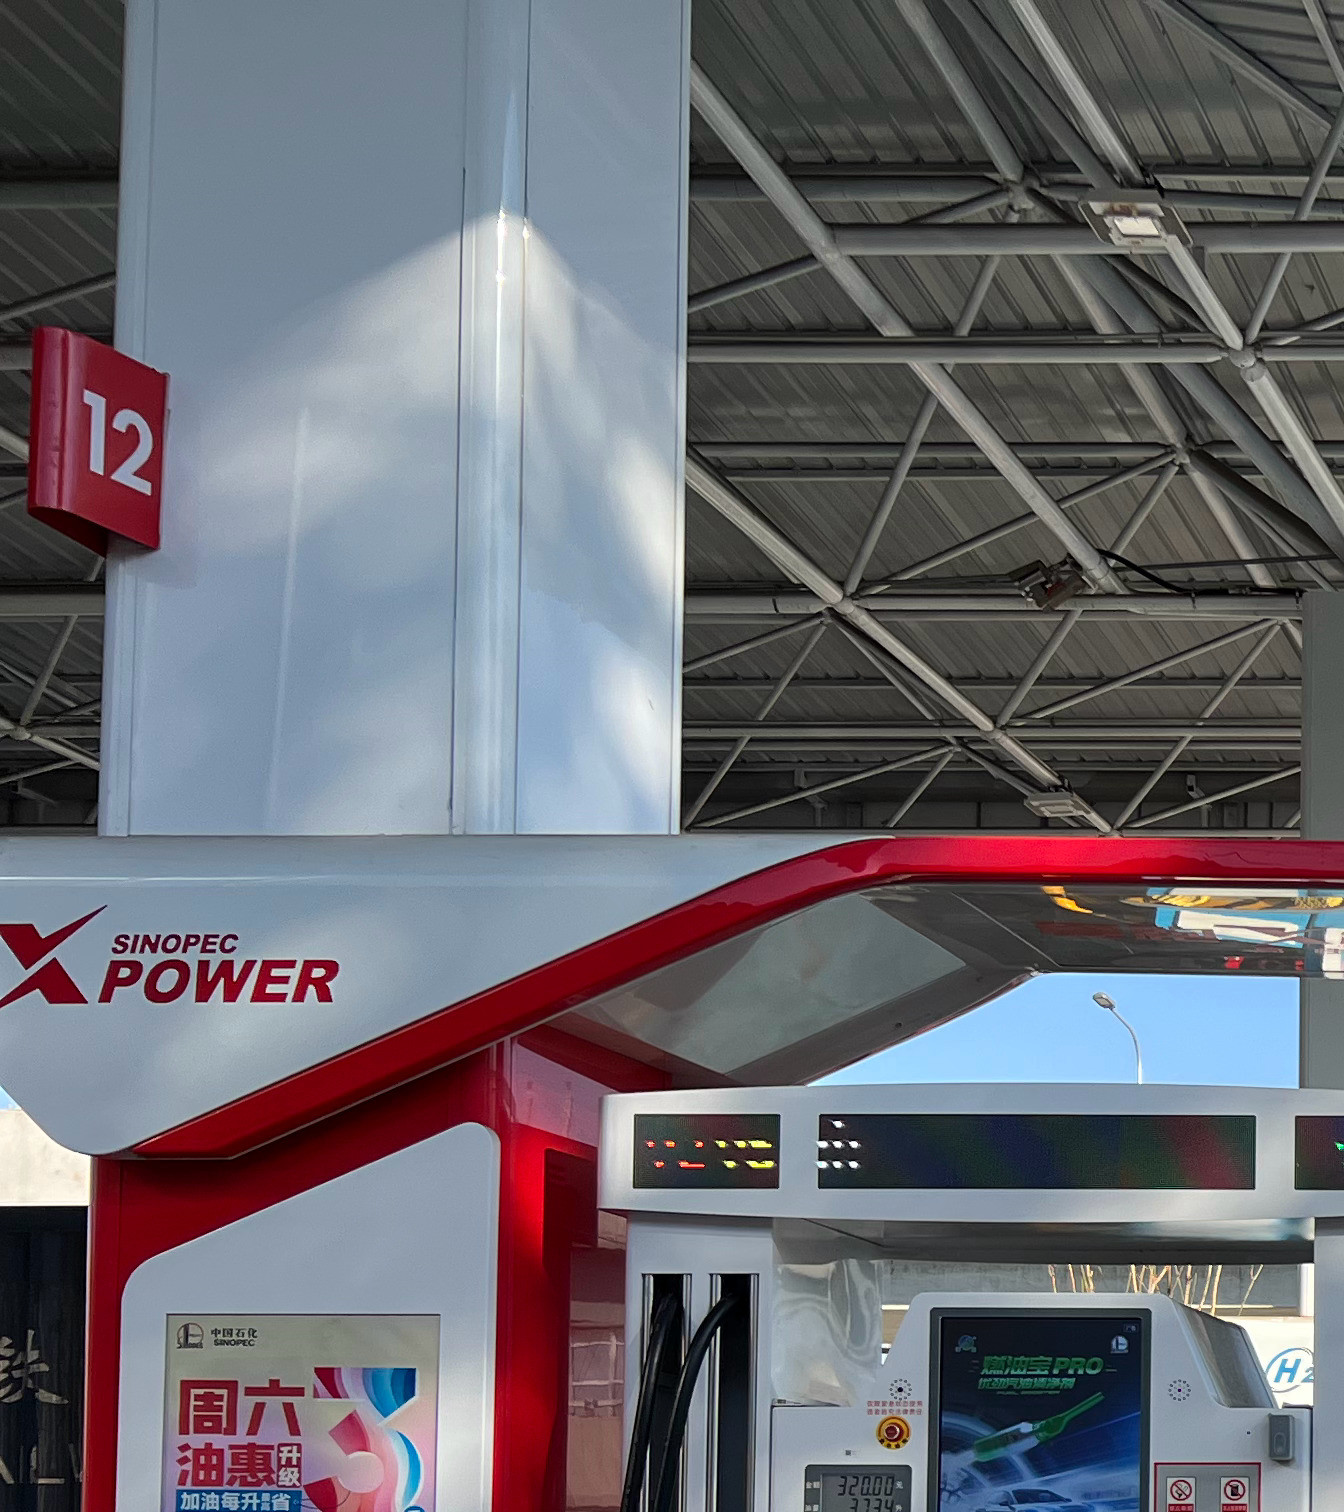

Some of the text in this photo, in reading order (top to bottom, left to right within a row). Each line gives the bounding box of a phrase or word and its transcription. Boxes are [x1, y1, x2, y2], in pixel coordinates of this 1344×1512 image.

[82, 389, 153, 496] 12
[111, 933, 239, 955] SINOPEC
[98, 959, 340, 1004] POWER
[210, 1327, 258, 1339] 中国石化
[213, 1339, 256, 1347] SINOPEC
[1052, 1356, 1104, 1376] PRO
[178, 1378, 306, 1437] 周六
[176, 1442, 301, 1488] 油惠 升级
[838, 1475, 895, 1497] 320.00
